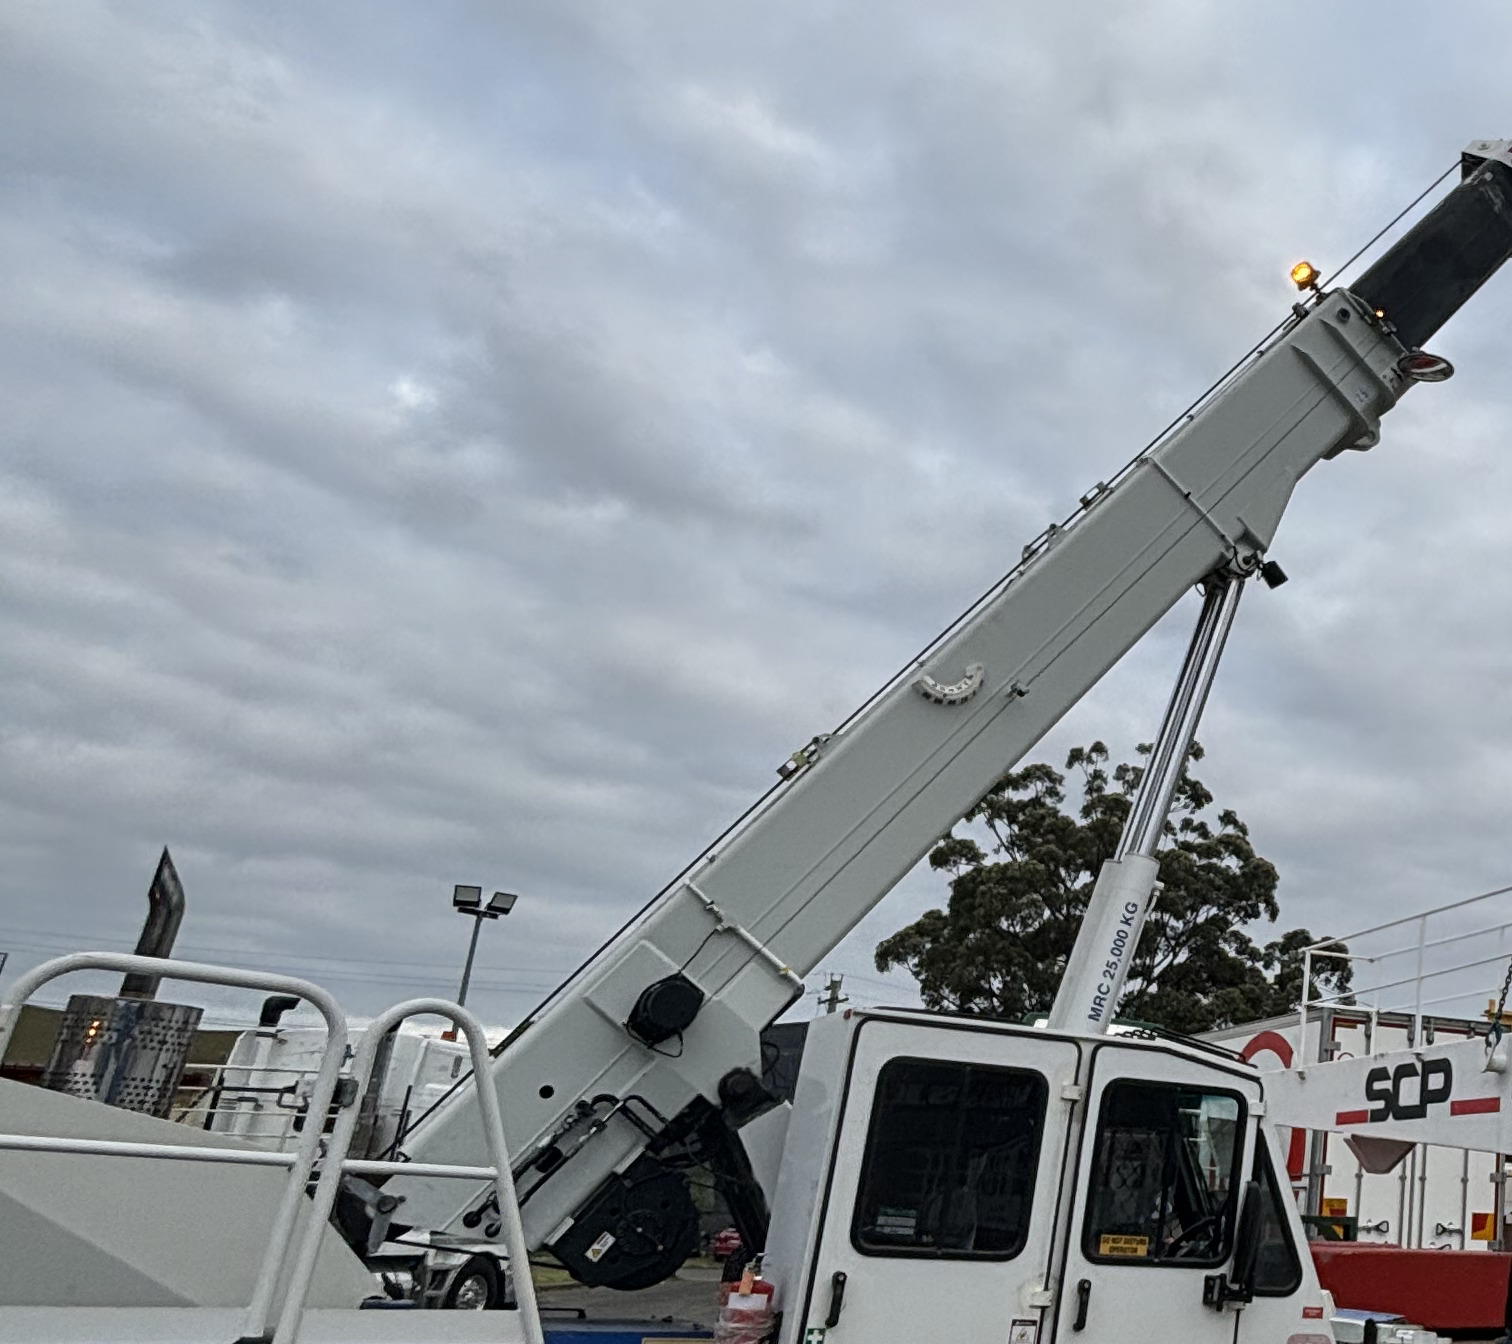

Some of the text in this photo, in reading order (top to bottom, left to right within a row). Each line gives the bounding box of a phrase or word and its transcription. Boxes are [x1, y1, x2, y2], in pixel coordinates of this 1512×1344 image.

[1088, 982, 1110, 1022] MRC
[1120, 901, 1139, 927] KG
[1365, 1057, 1453, 1123] SCP
